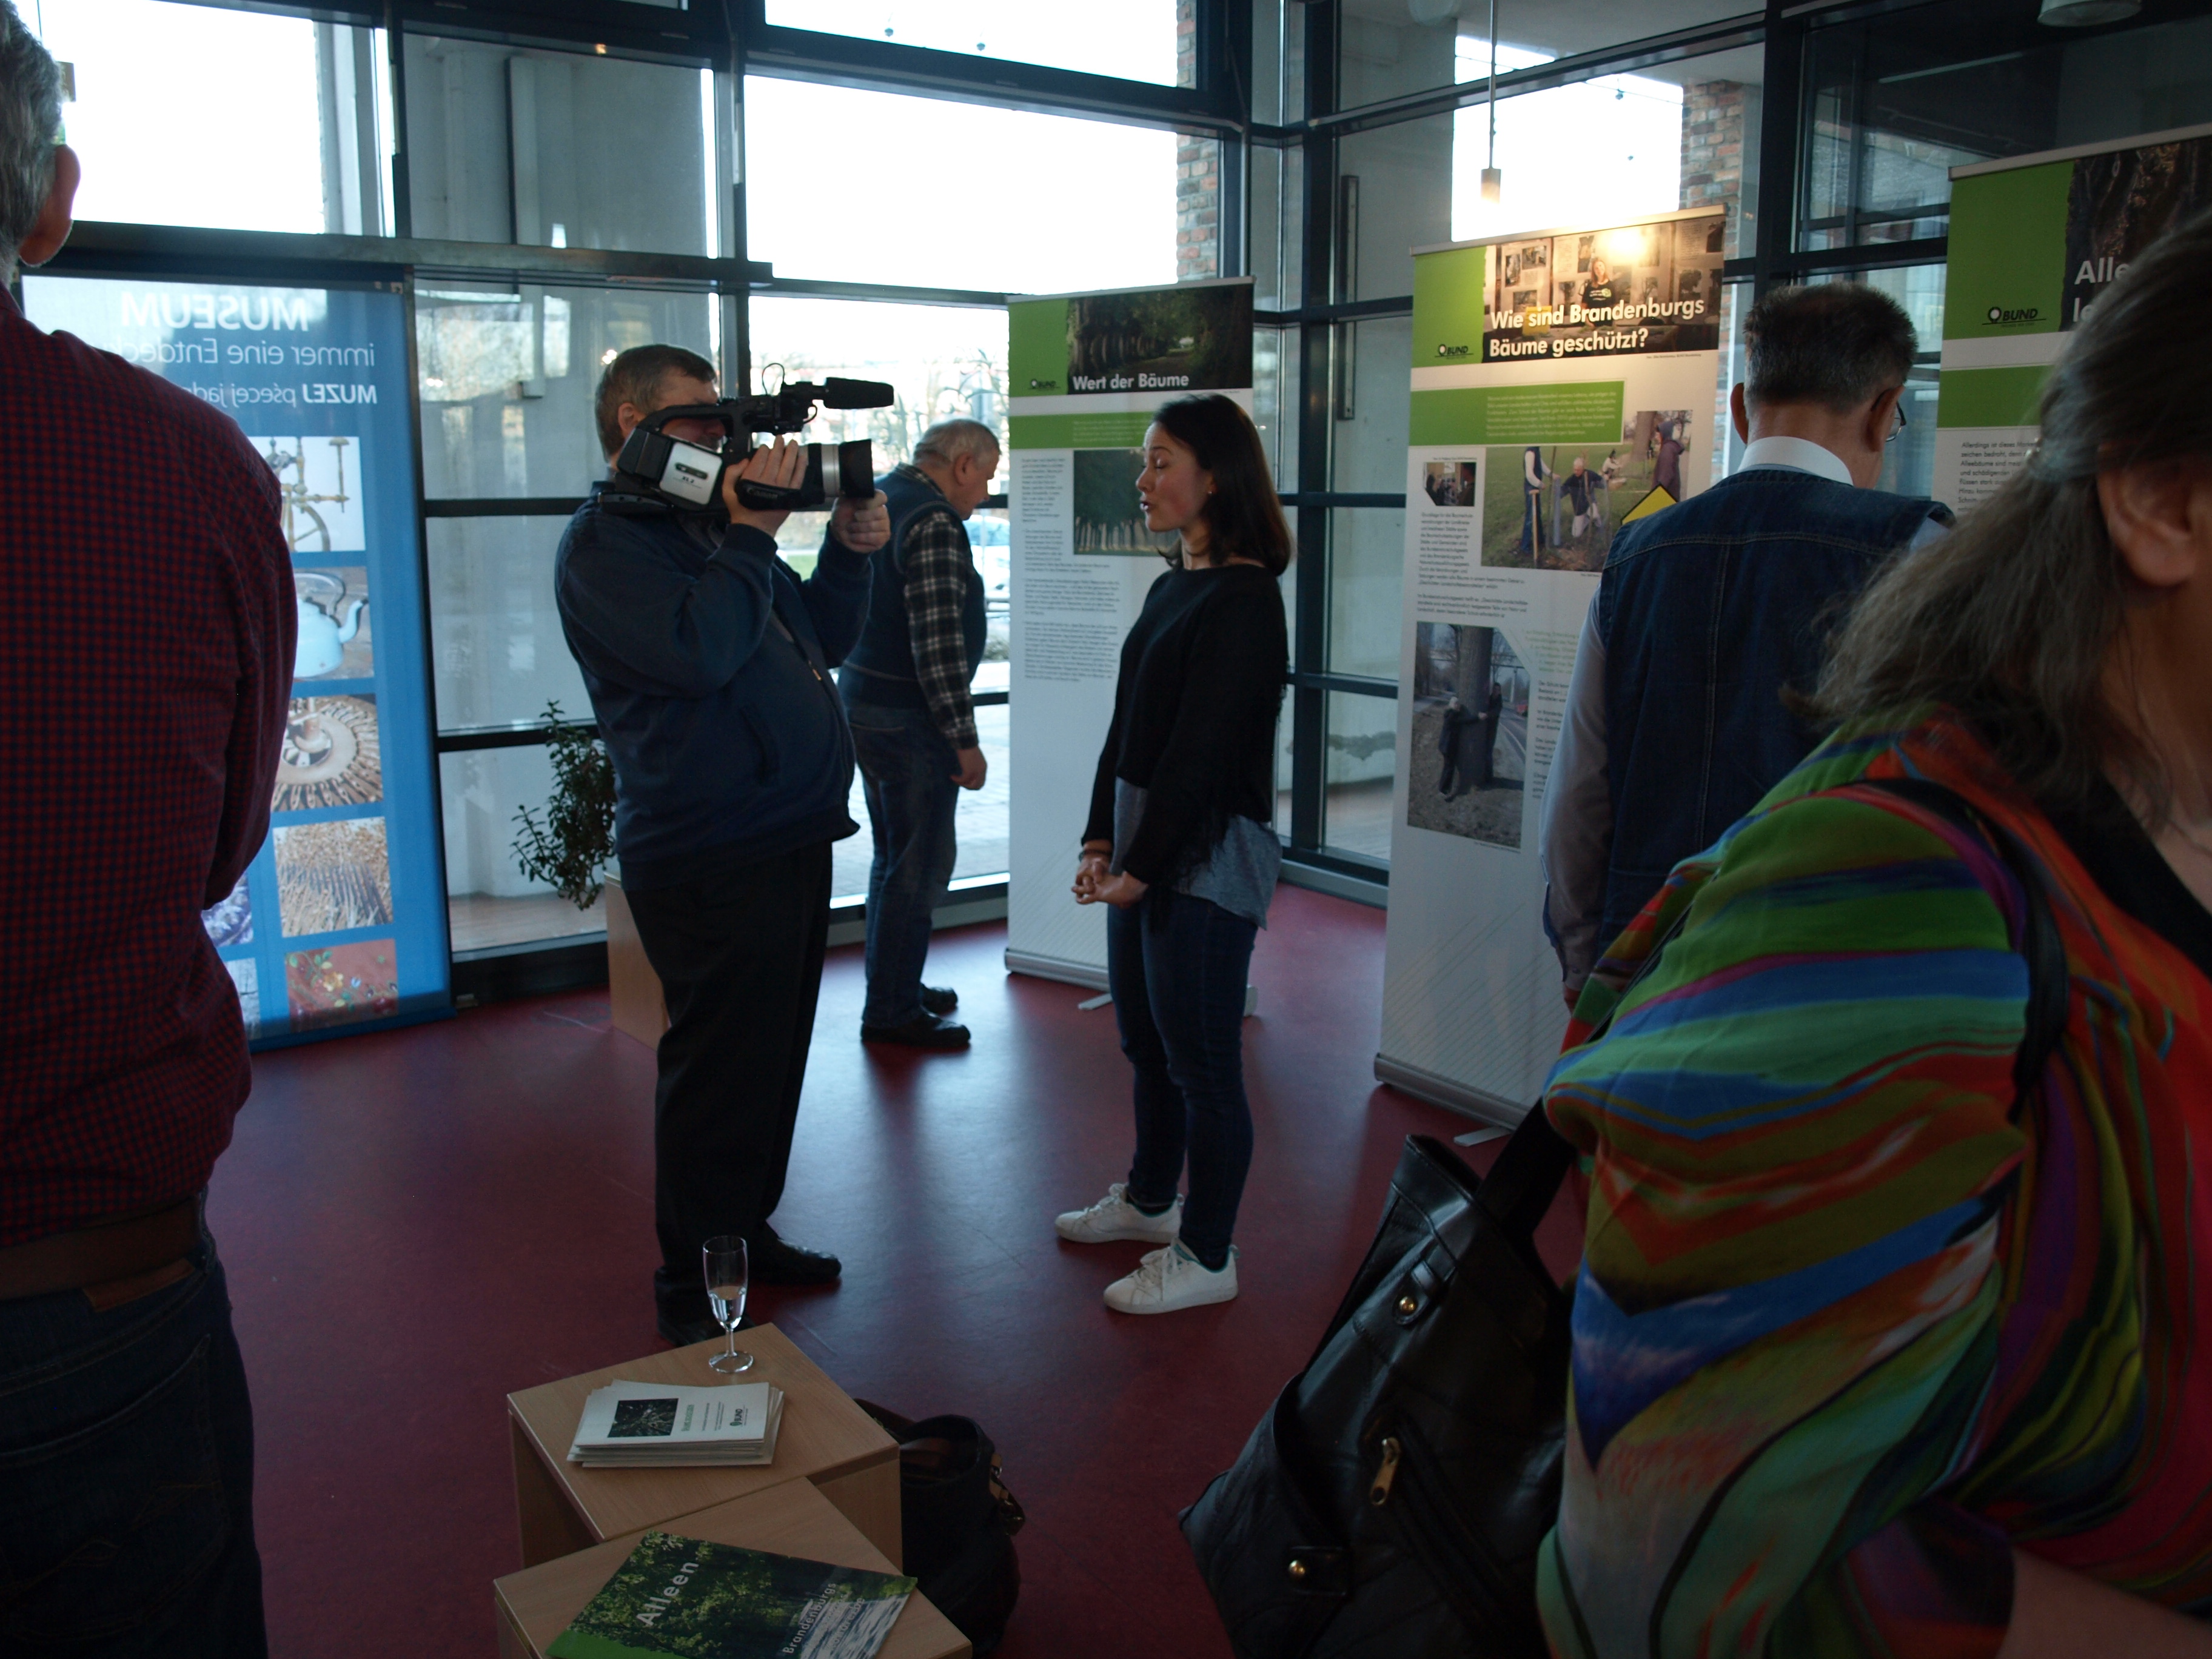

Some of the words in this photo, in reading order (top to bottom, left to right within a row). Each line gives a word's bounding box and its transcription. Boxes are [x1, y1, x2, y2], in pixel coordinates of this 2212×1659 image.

[2074, 256, 2130, 285] Alle
[1491, 310, 1523, 329] Wie
[1528, 305, 1564, 327] sind
[1570, 297, 1704, 323] Brandenburgs
[2003, 309, 2038, 321] BUND
[1490, 338, 1547, 357] Bäume
[1552, 328, 1649, 358] geschützt?
[1073, 375, 1107, 390] Wert
[1110, 374, 1134, 389] der
[1138, 373, 1189, 388] Bäume
[636, 1562, 699, 1626] Alleen
[782, 1583, 837, 1654] Brandenburgs
